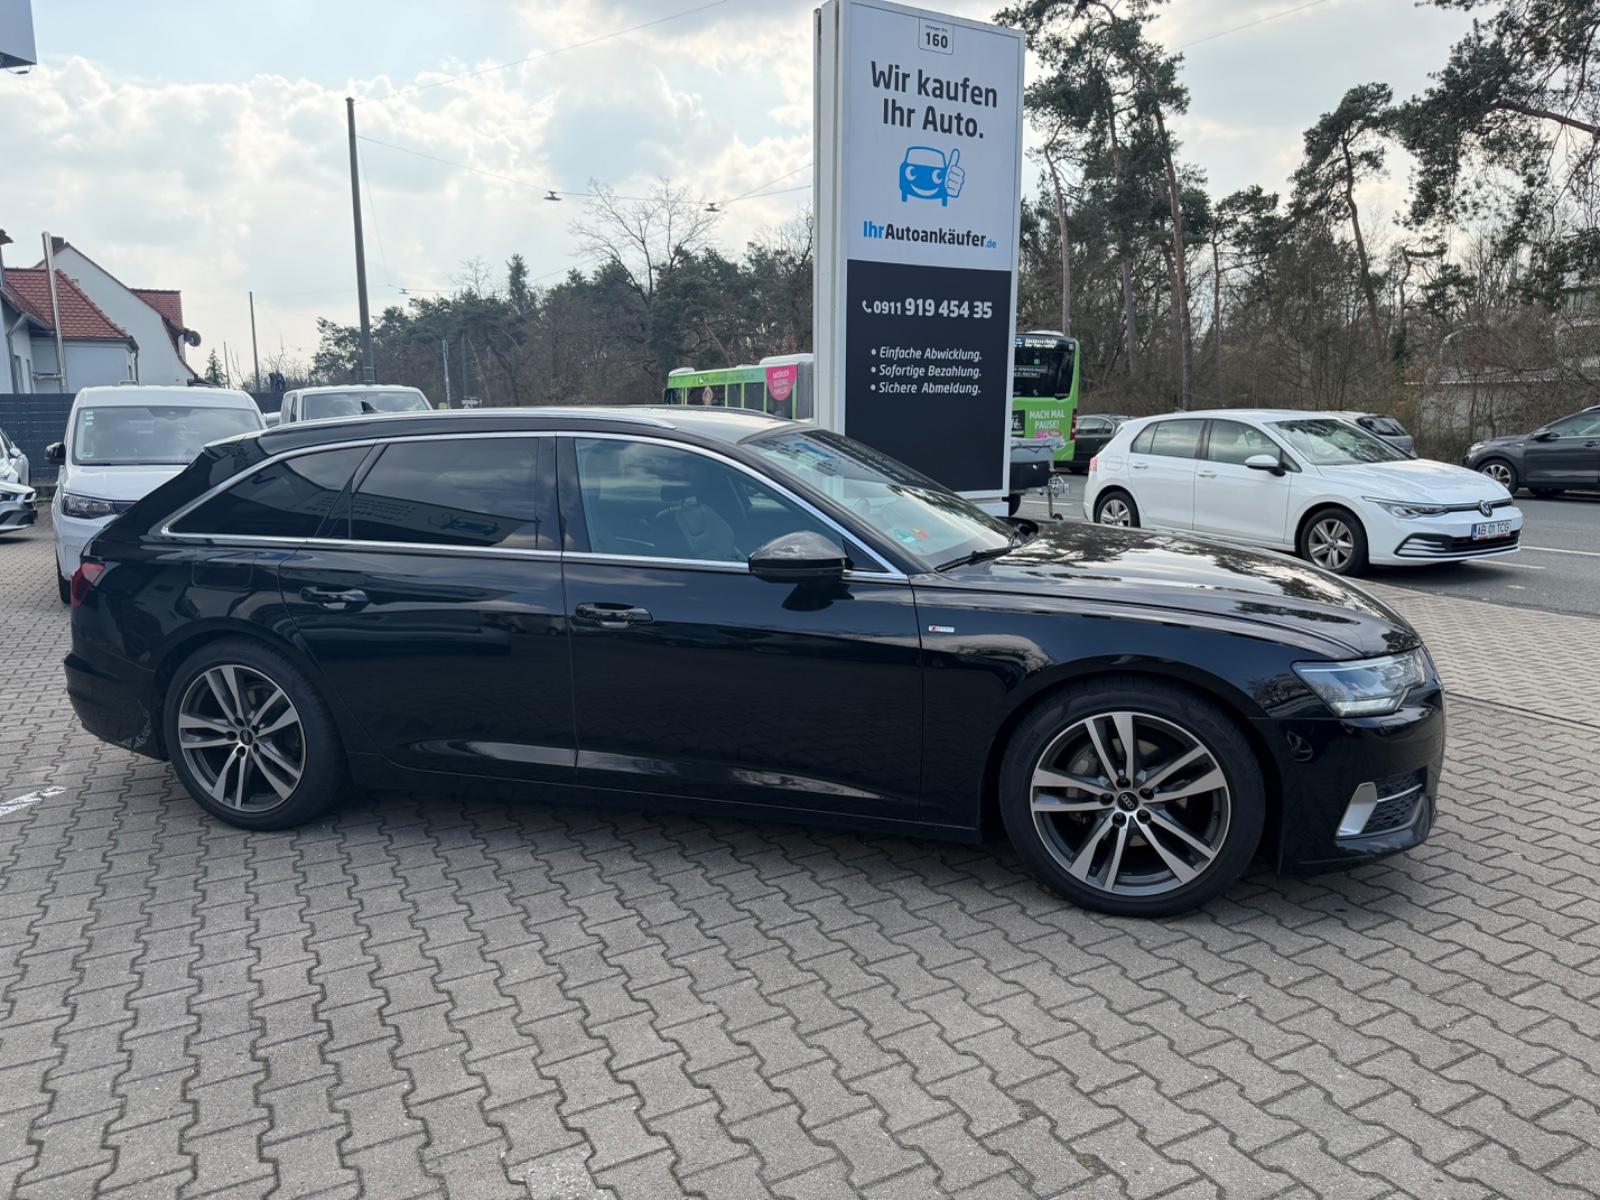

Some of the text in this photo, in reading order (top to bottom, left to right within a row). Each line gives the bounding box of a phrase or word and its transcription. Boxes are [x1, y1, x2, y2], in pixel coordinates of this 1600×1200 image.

[926, 32, 948, 48] 160
[871, 61, 997, 108] Wir kaufen
[884, 98, 984, 138] Ihr Auto.
[874, 298, 992, 318] 0911 919 454 35
[880, 347, 982, 362] Einfache Abwicklung.
[880, 364, 982, 378] Sofortige Bezahlung.
[879, 382, 982, 396] Sichere Abmeldung.
[1029, 409, 1066, 419] MACH MAL
[1478, 524, 1486, 535] AB
